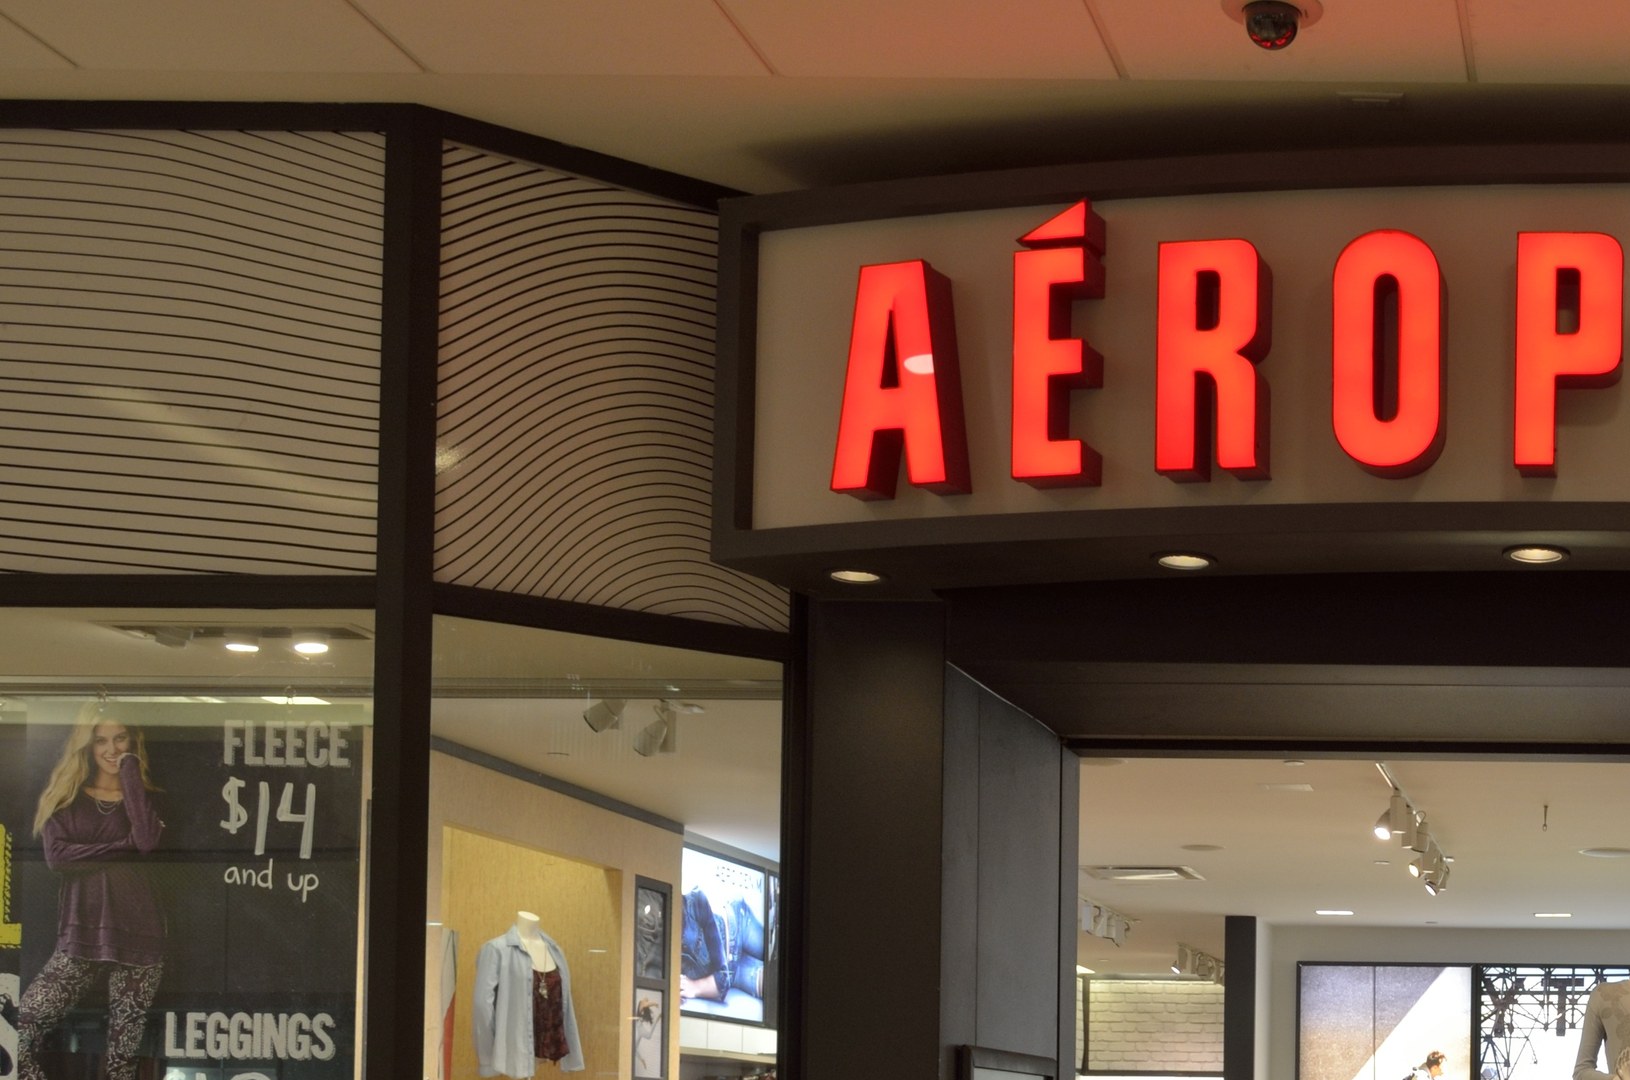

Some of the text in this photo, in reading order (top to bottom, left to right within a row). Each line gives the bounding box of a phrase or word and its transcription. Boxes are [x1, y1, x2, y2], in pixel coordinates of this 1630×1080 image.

[224, 720, 351, 768] FLEECE
[220, 776, 316, 859] $14
[224, 858, 319, 903] and up
[165, 1012, 336, 1061] LEGGINGS
